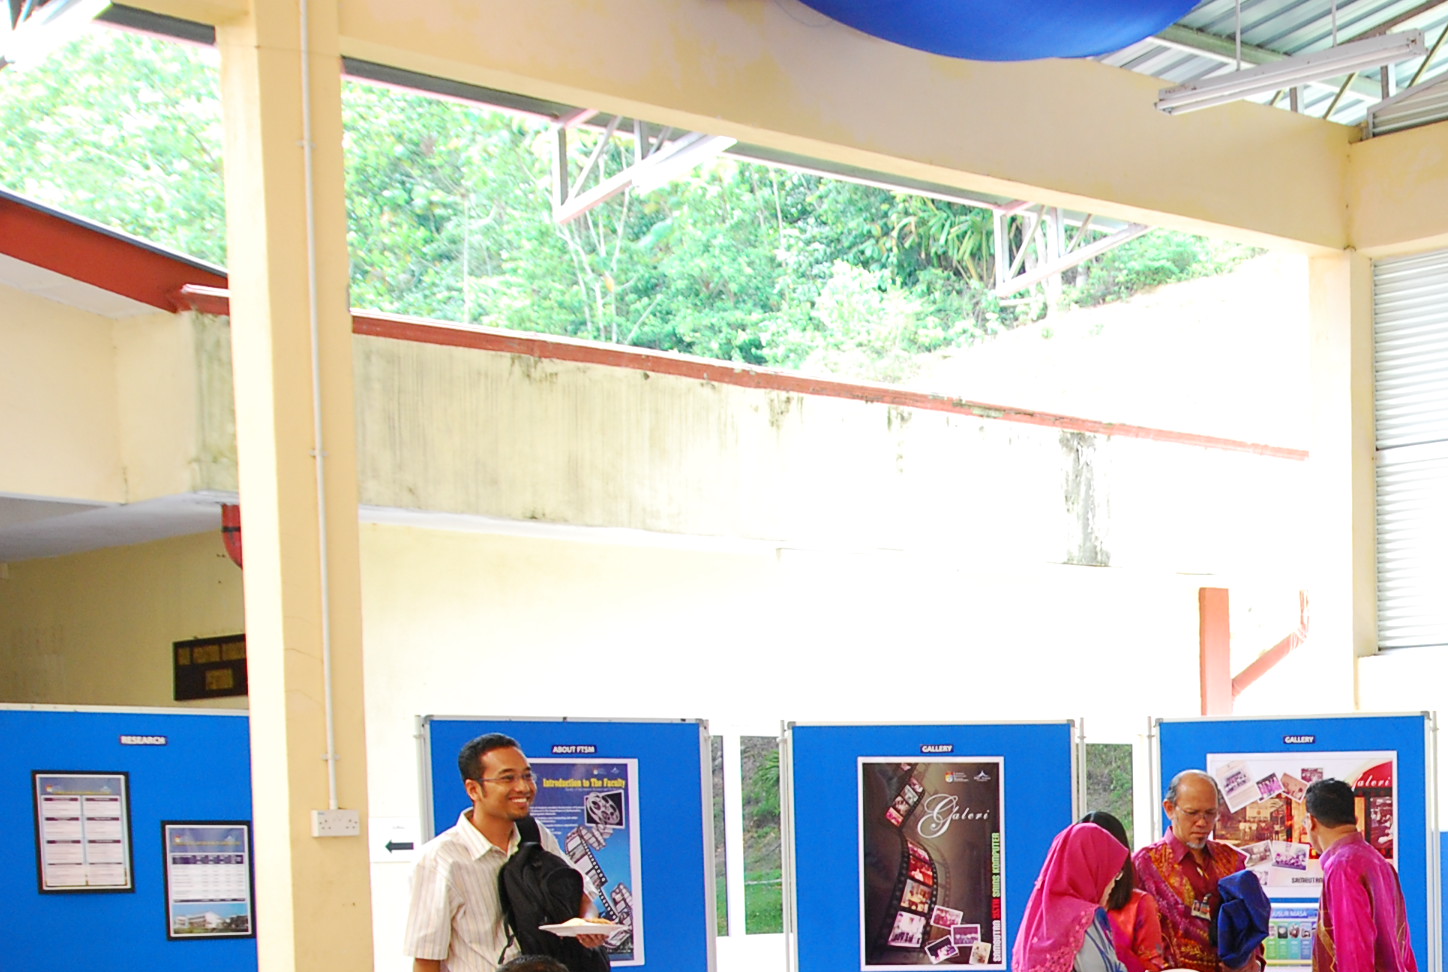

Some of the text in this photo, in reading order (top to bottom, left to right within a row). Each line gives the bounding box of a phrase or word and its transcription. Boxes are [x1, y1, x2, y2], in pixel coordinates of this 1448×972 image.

[120, 735, 166, 745] RESEARCH
[1284, 736, 1314, 744] GALLERY
[552, 746, 576, 754] ABOUT
[922, 745, 953, 753] GALLERY
[543, 778, 625, 789] Introduction to The Faculty
[917, 793, 990, 838] Galeri
[991, 832, 1000, 874] KOMPUTER
